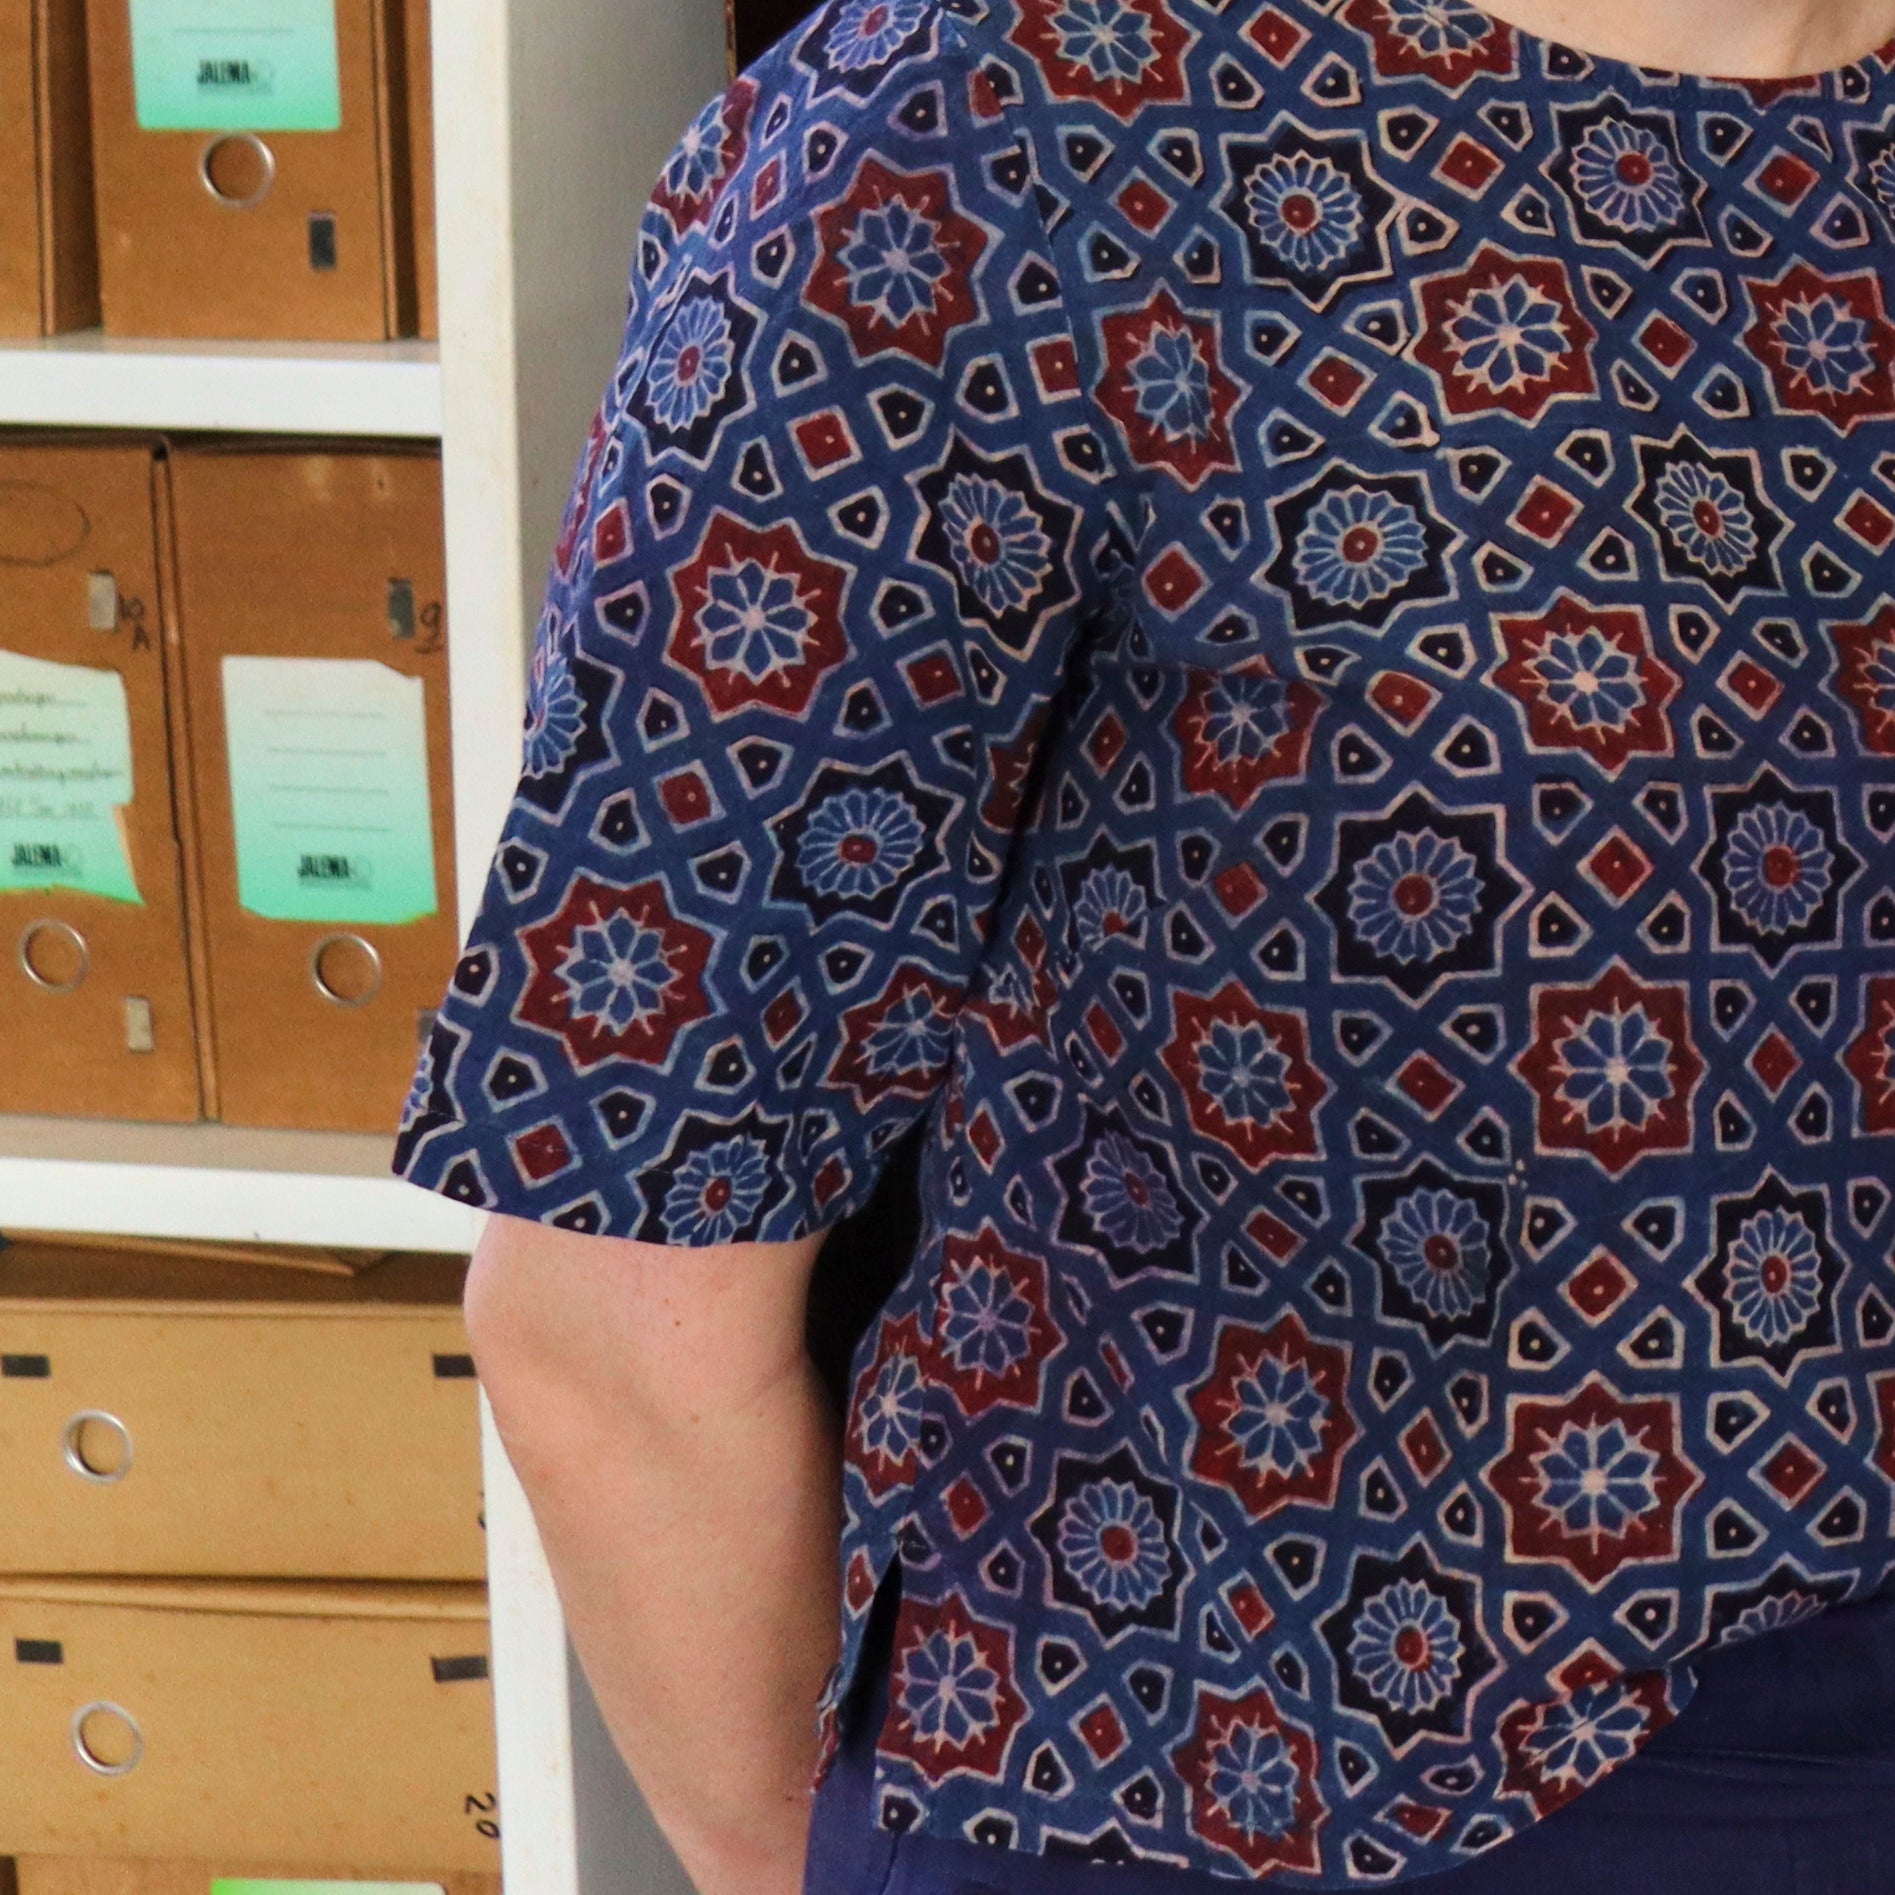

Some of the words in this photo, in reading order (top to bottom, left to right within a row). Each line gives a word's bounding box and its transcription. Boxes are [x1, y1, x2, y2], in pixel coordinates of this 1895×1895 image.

[196, 58, 250, 84] JALEMA
[12, 844, 62, 867] JALEMA
[296, 854, 349, 879] JALEMA
[464, 1791, 501, 1840] 20
